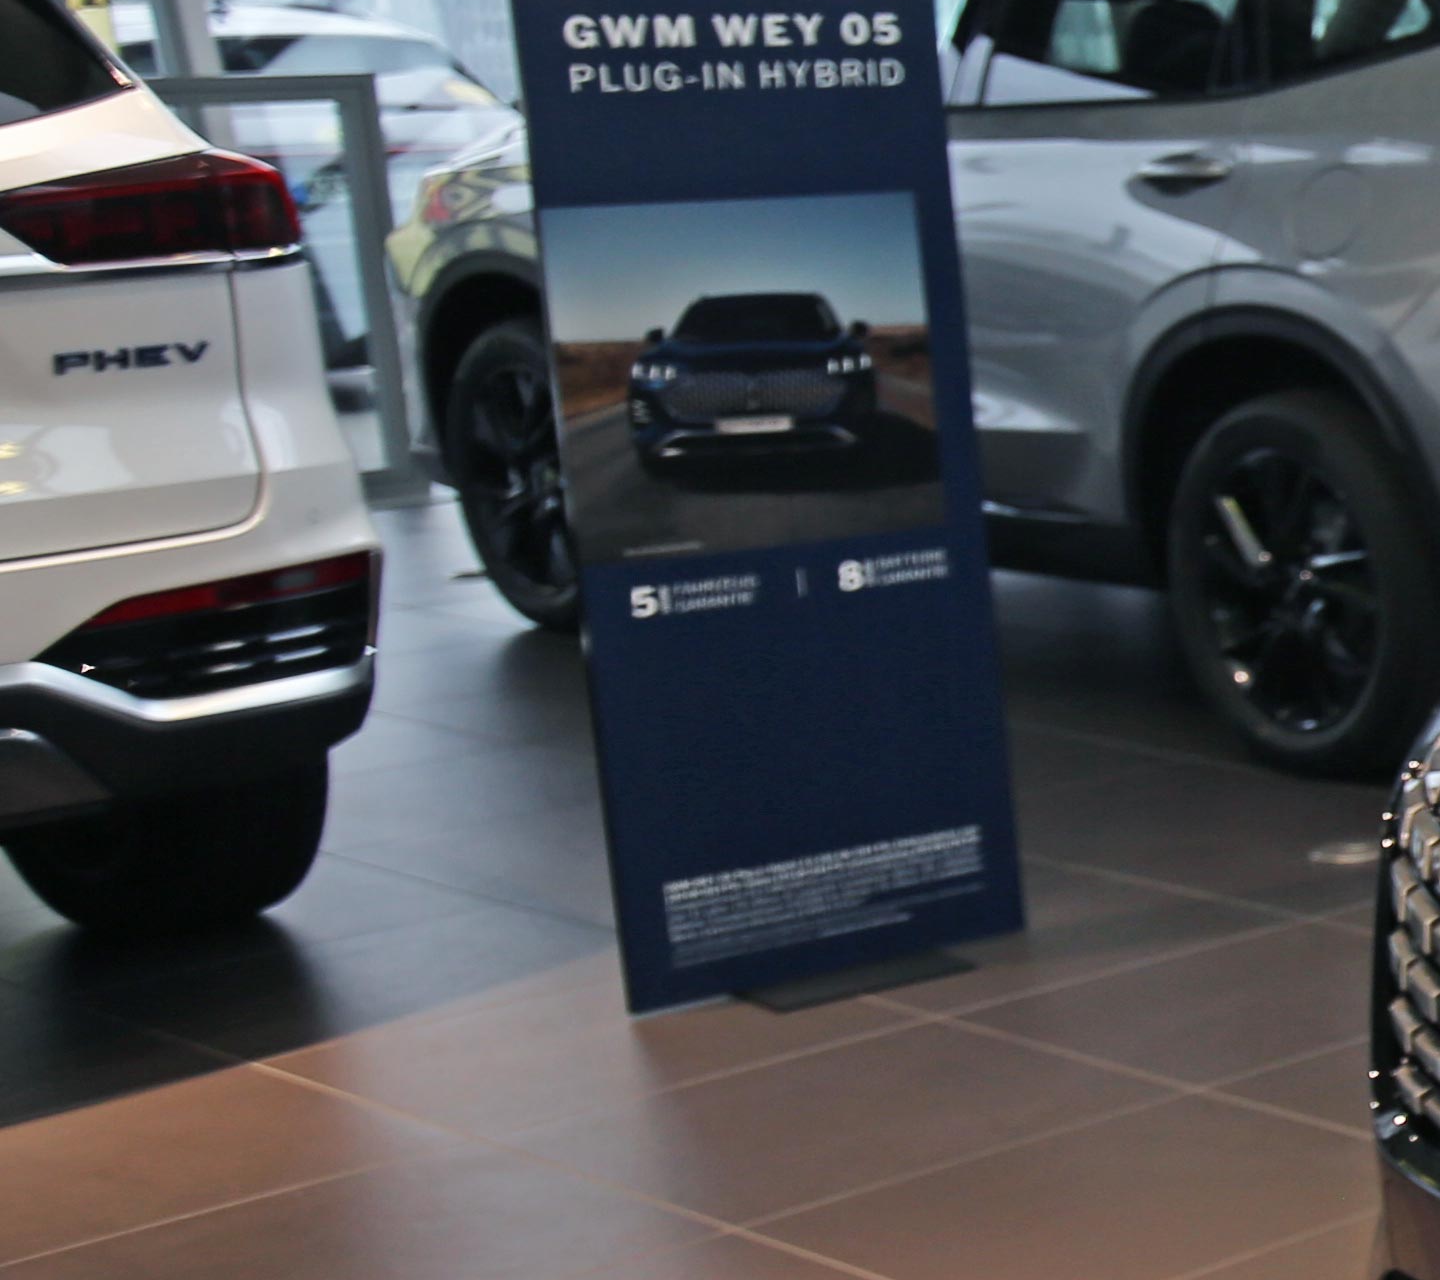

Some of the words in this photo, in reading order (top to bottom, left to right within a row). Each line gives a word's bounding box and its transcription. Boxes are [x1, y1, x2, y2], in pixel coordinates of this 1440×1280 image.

[562, 14, 697, 48] GWM
[711, 13, 824, 47] WEY
[839, 12, 903, 46] 05
[569, 59, 746, 93] PLUG-IN
[758, 58, 906, 89] HYBRID
[53, 341, 209, 376] PHEV
[837, 559, 865, 592] 8
[630, 585, 659, 618] 5
